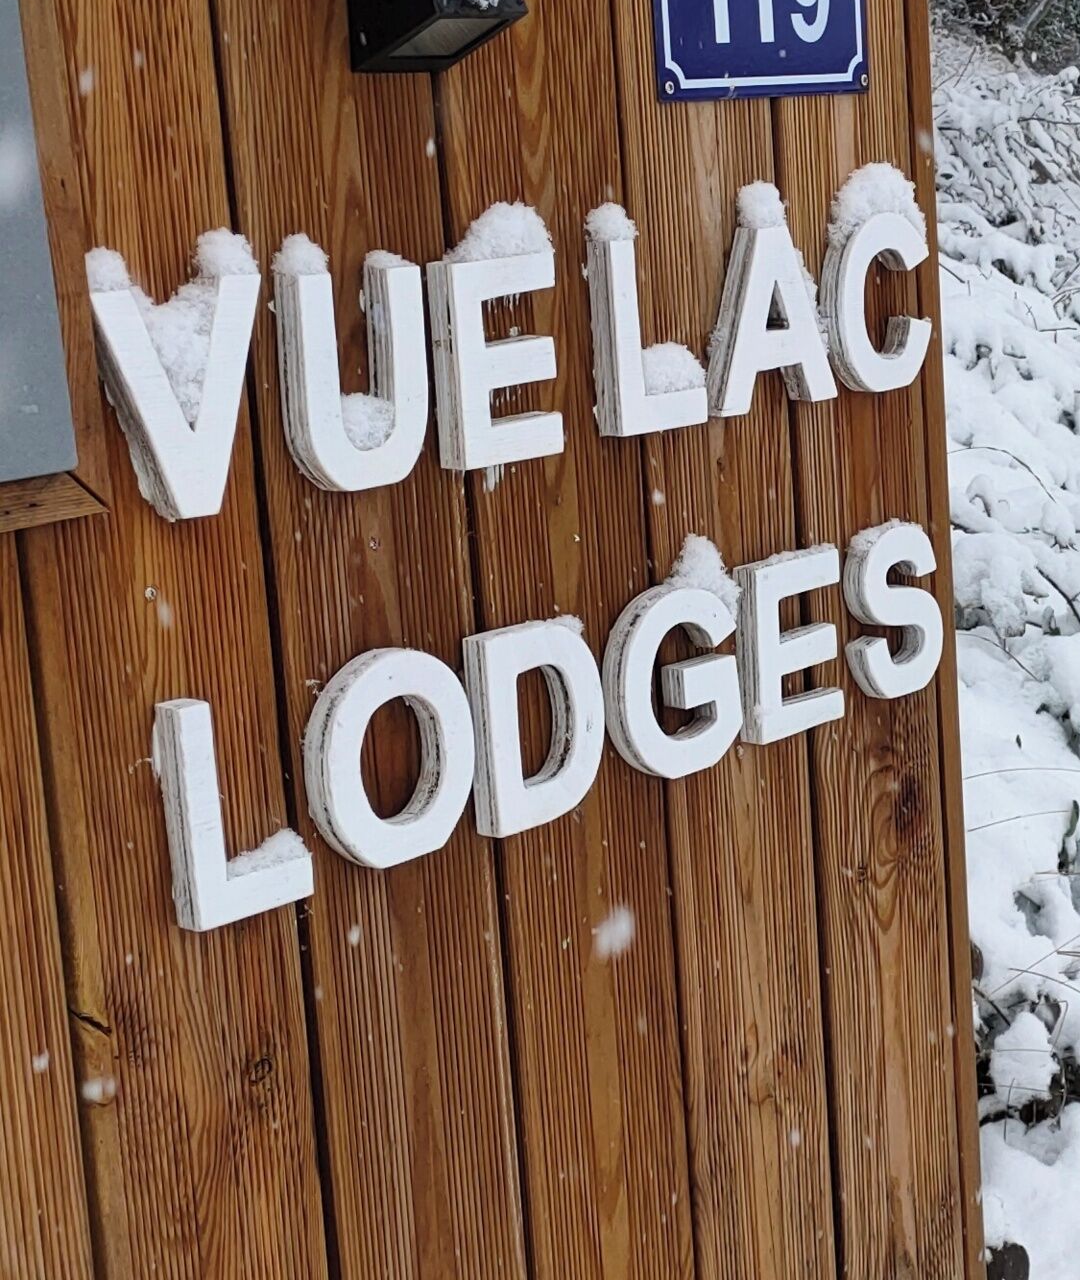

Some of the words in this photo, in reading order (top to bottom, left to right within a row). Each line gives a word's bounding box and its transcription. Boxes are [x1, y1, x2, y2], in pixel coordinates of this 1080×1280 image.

[88, 252, 564, 520] VUE
[588, 210, 932, 438] LAC
[154, 523, 944, 932] LODGES
